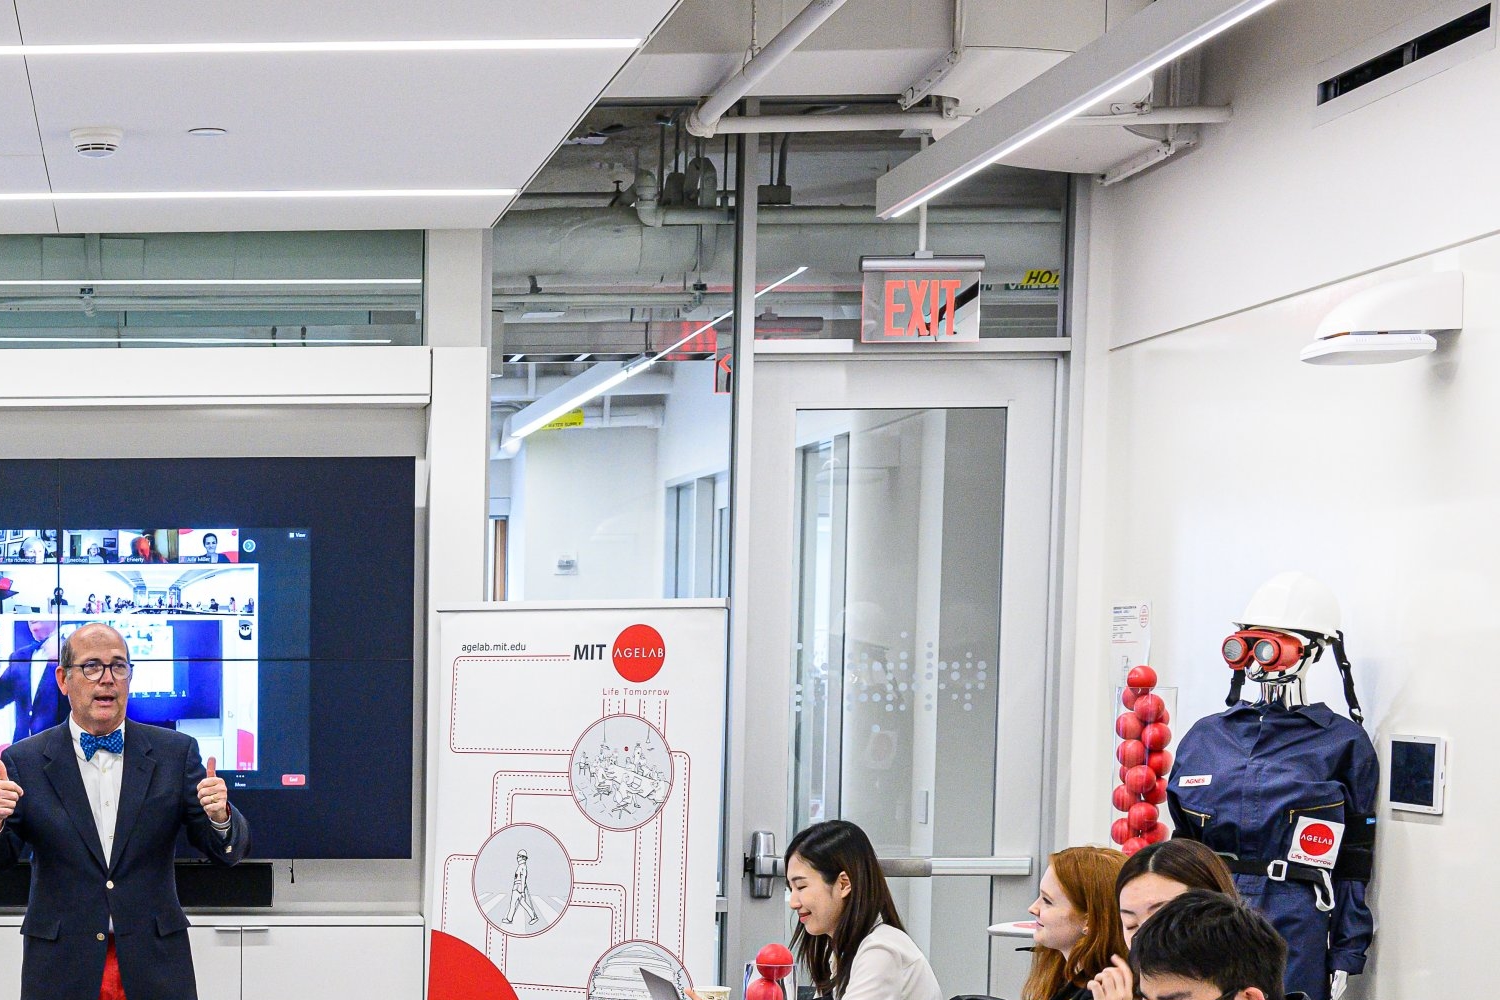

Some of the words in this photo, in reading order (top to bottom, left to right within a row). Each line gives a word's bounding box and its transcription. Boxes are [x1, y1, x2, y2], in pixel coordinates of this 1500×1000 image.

[884, 279, 962, 337] EXIT
[461, 642, 527, 652] agelab.mit.edu
[573, 644, 607, 661] MIT
[613, 647, 665, 659] AGELAB
[602, 687, 619, 696] Life
[623, 688, 670, 696] Tomorrow
[1300, 833, 1333, 846] AGELAB
[1303, 855, 1332, 866] Tomorrow
